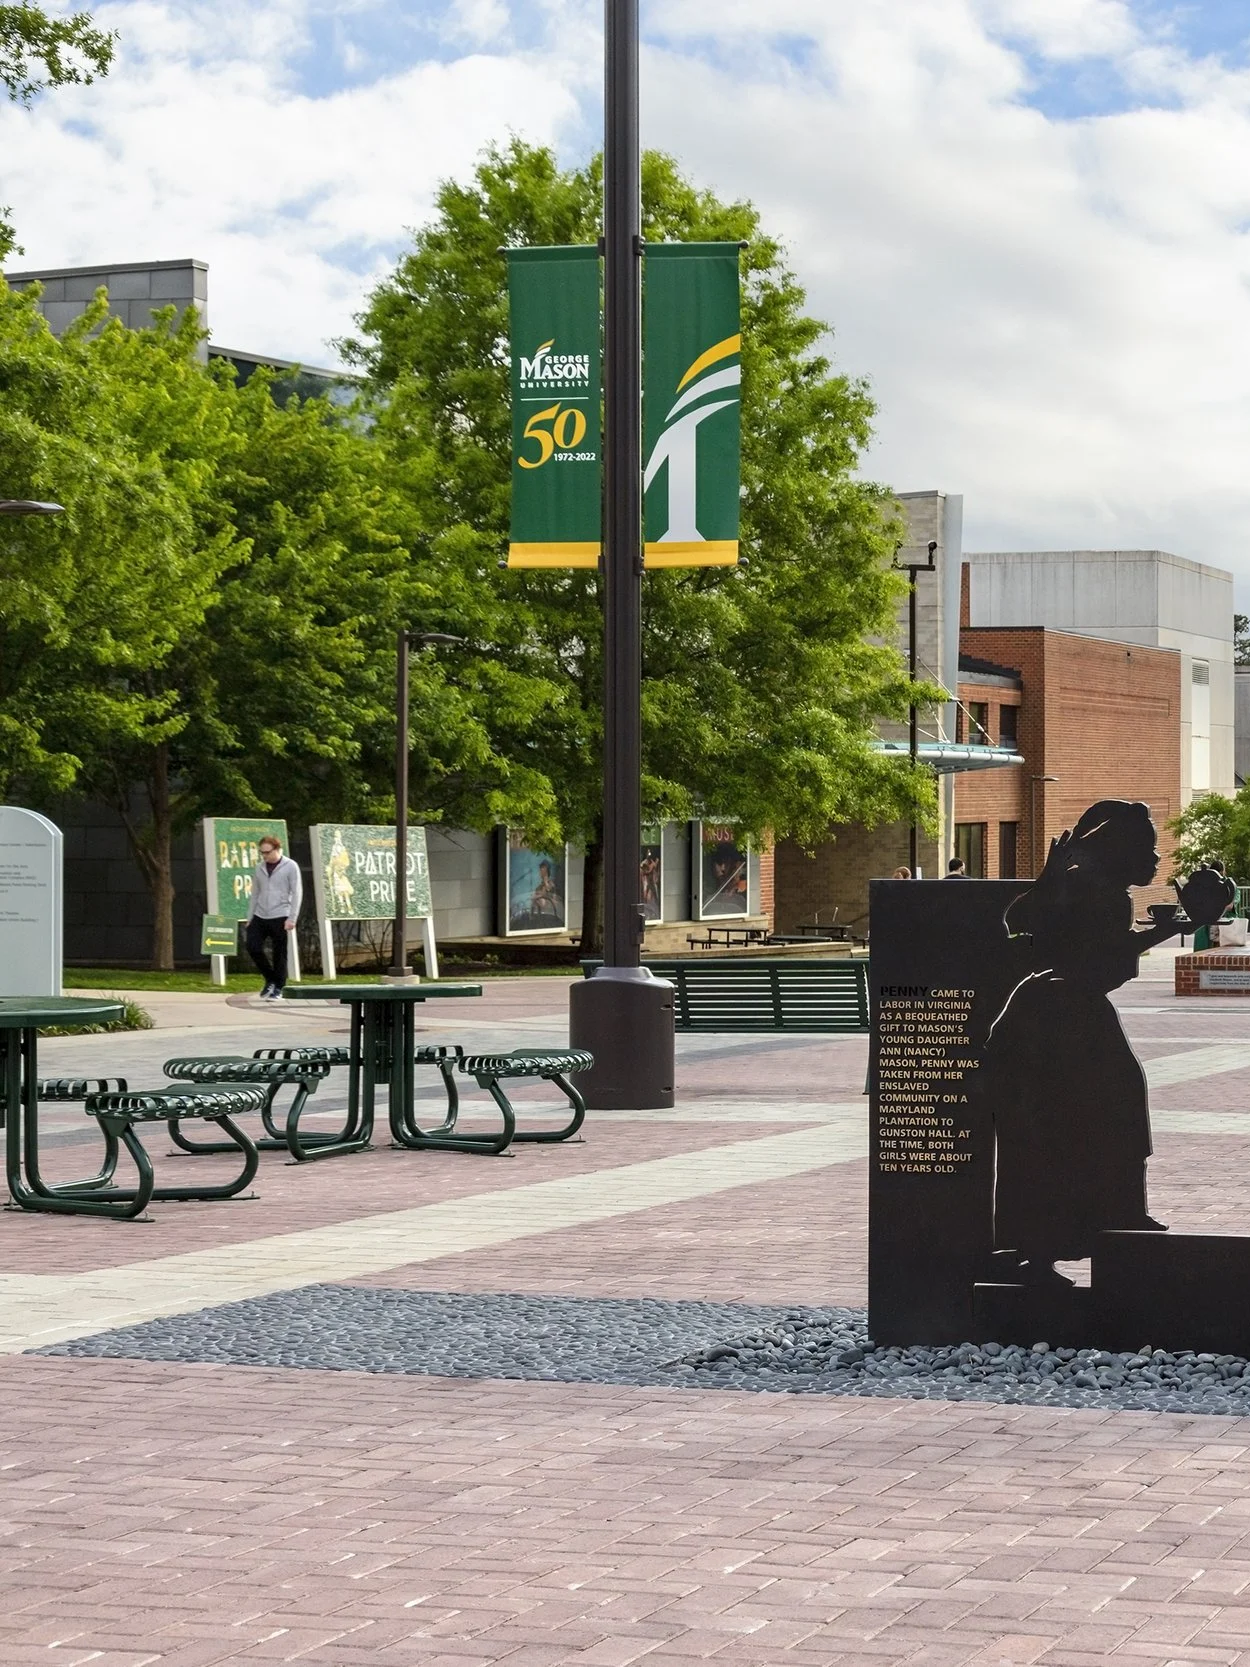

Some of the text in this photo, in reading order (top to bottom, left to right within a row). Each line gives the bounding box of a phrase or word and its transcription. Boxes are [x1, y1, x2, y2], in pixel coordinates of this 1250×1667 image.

[545, 355, 589, 364] GEORGE
[520, 354, 589, 380] MASON
[518, 402, 586, 469] 50
[554, 453, 595, 461] 1972-2022
[355, 852, 424, 874] PATROT
[370, 881, 417, 902] PRIE
[880, 986, 928, 997] PENNY
[962, 990, 974, 998] TO
[880, 1001, 971, 1010] LABOR IN VIRGINIA
[905, 1013, 968, 1021] BEQUEATHED
[880, 1024, 899, 1032] GIFT
[918, 1025, 963, 1033] MASON'S
[880, 1036, 969, 1044] YOUNG DAUGHTER
[904, 1047, 946, 1057] (NANCY)
[880, 1059, 979, 1068] MASON, PENNY WAS
[914, 1071, 941, 1079] FROM
[880, 1082, 929, 1091] ENSLAVED
[880, 1094, 967, 1103] COMMUNITY ON A
[880, 1106, 935, 1114] MARYLAND
[880, 1117, 953, 1126] PLANTATION TO
[880, 1129, 971, 1138] GUNSTON HALL. AT
[880, 1140, 953, 1150] THE TIME, BOTH
[880, 1152, 972, 1161] GIRLS WERE ABOUT
[880, 1164, 956, 1173] TEN YEARS OLD.
